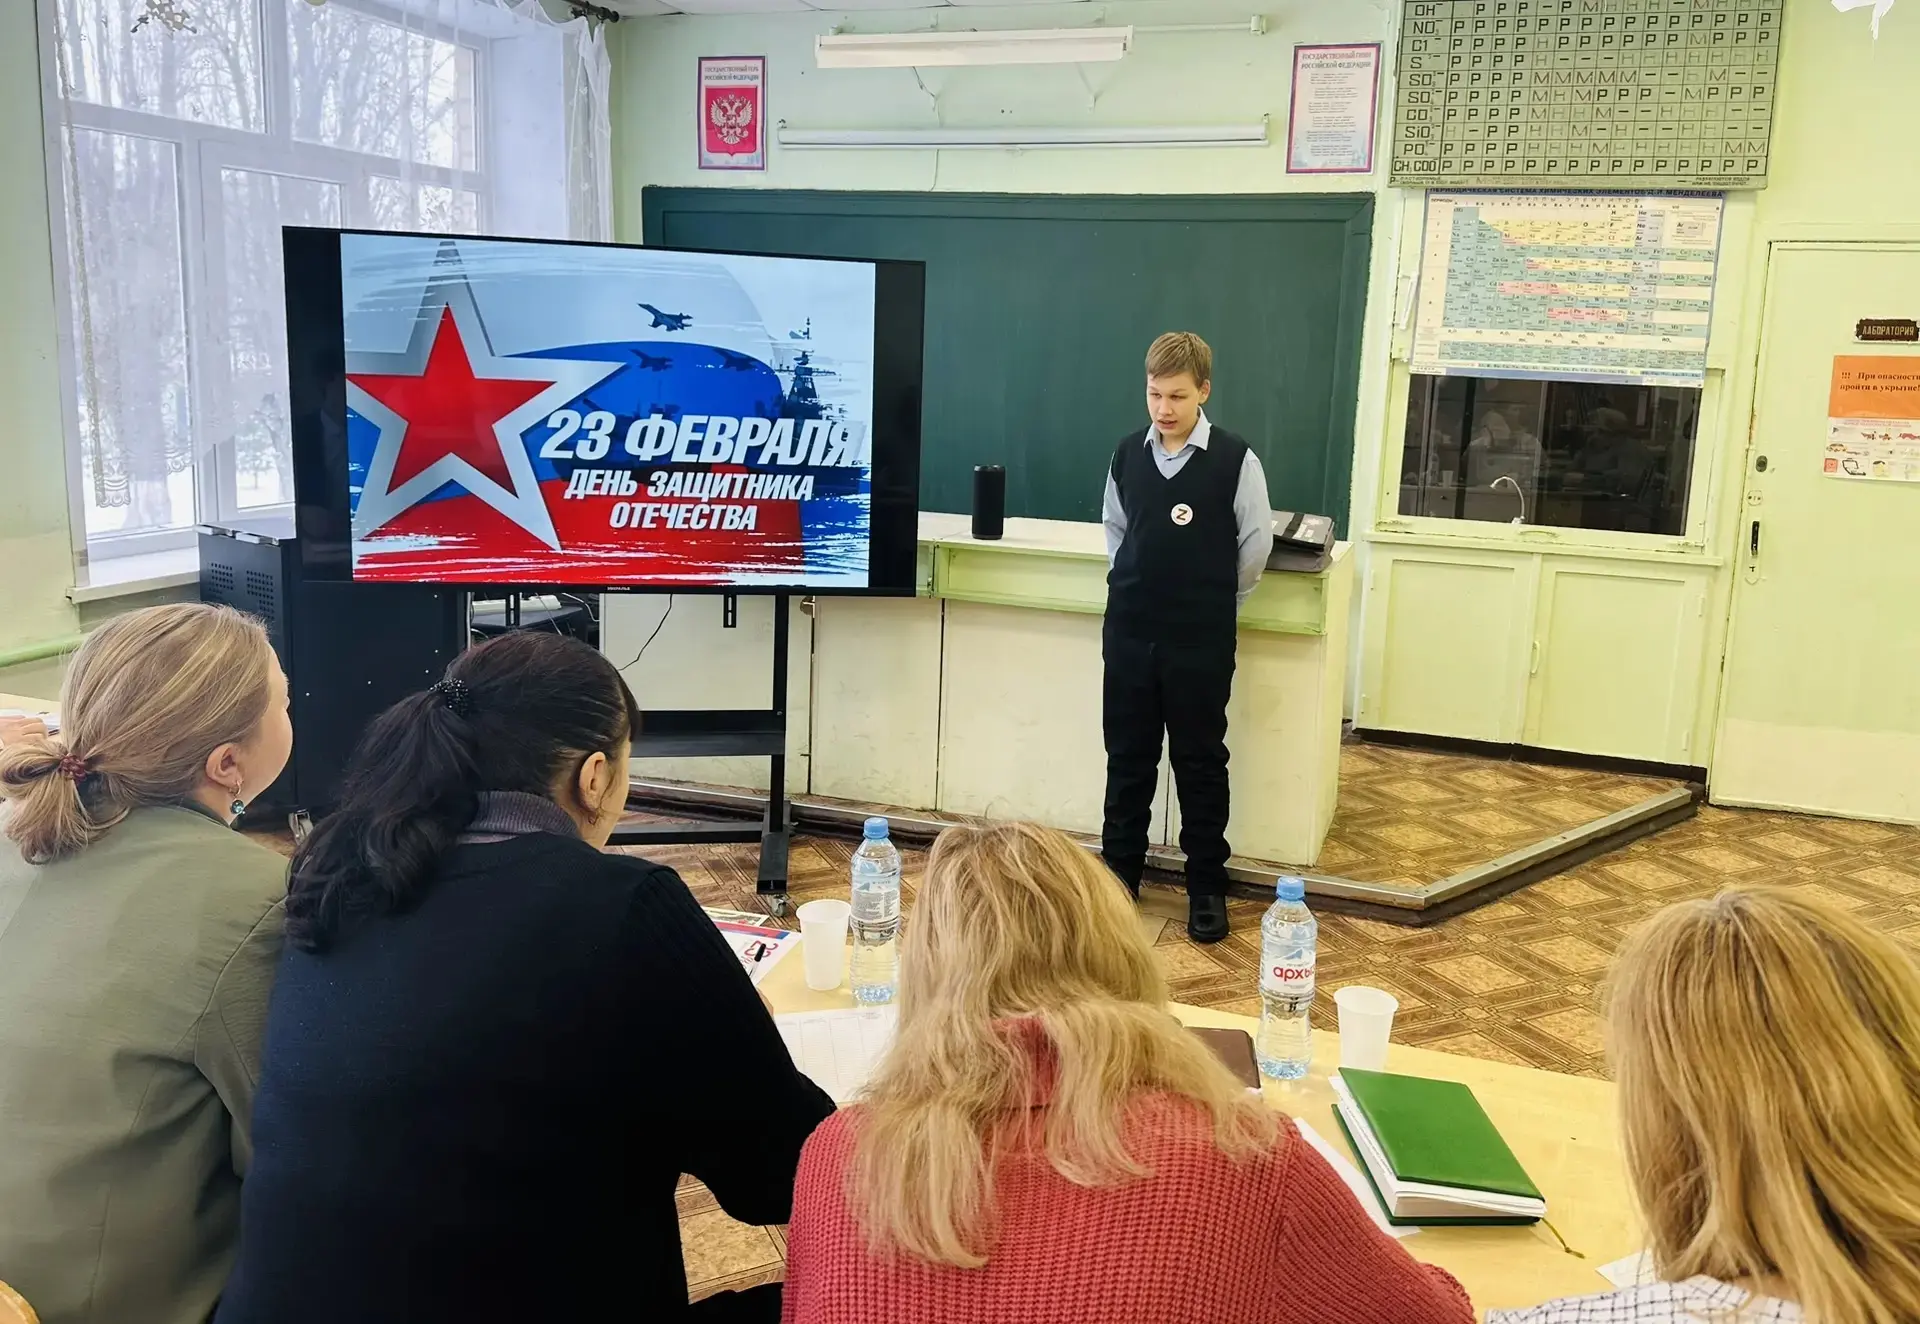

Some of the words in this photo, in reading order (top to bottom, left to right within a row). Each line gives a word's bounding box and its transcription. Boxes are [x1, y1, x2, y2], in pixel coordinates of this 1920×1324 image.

[1862, 326, 1914, 336] ЛАБОРАТОРИЯ
[1858, 372, 1876, 381] При
[539, 409, 616, 460] 23
[624, 413, 866, 467] ФЕВРАЛЯ
[563, 468, 638, 500] ДЕНЬ
[647, 469, 815, 502] ЗАЩИТНИКА
[609, 502, 758, 531] ОТЕЧЕСТВА
[1176, 508, 1188, 521] Z
